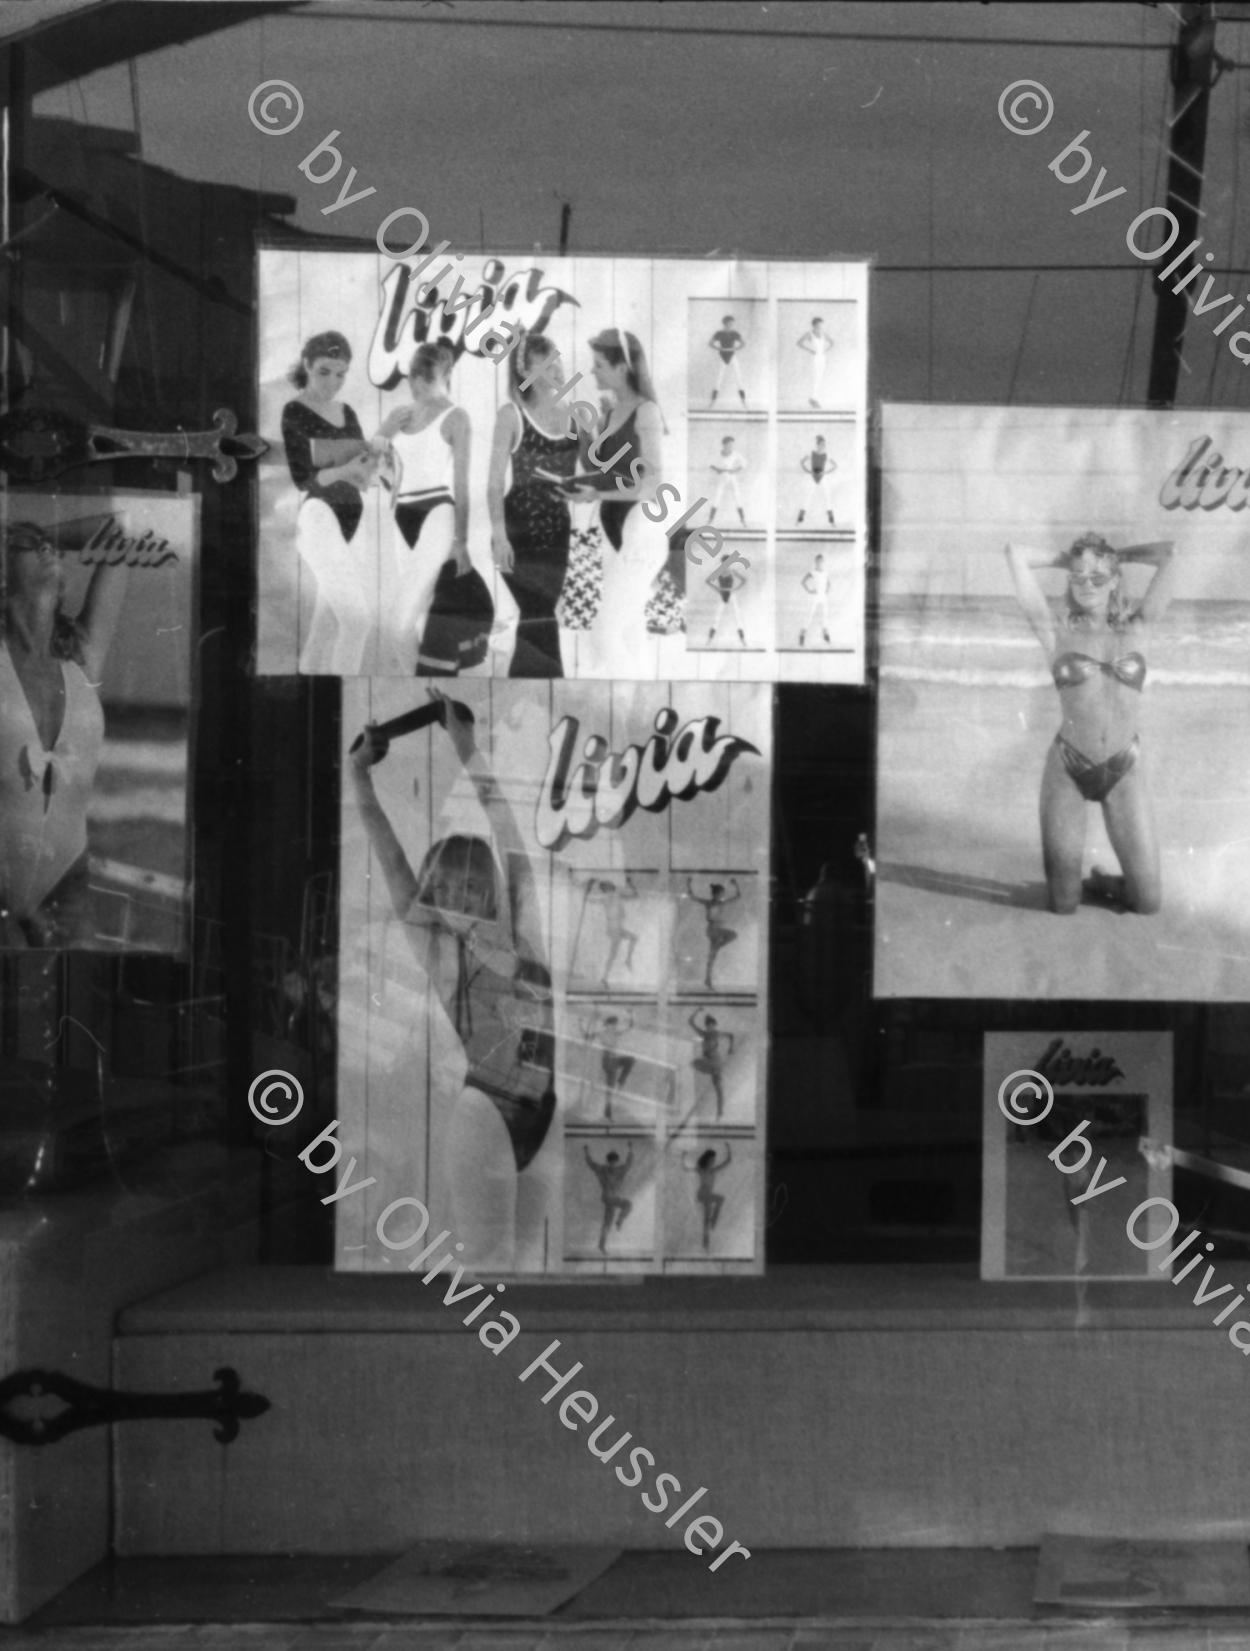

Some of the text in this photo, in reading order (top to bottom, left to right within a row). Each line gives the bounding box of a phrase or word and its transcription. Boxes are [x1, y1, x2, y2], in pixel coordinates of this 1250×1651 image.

[368, 259, 581, 391] livia
[79, 517, 179, 568] livia
[535, 707, 762, 852] livia
[1029, 1038, 1126, 1086] livia
